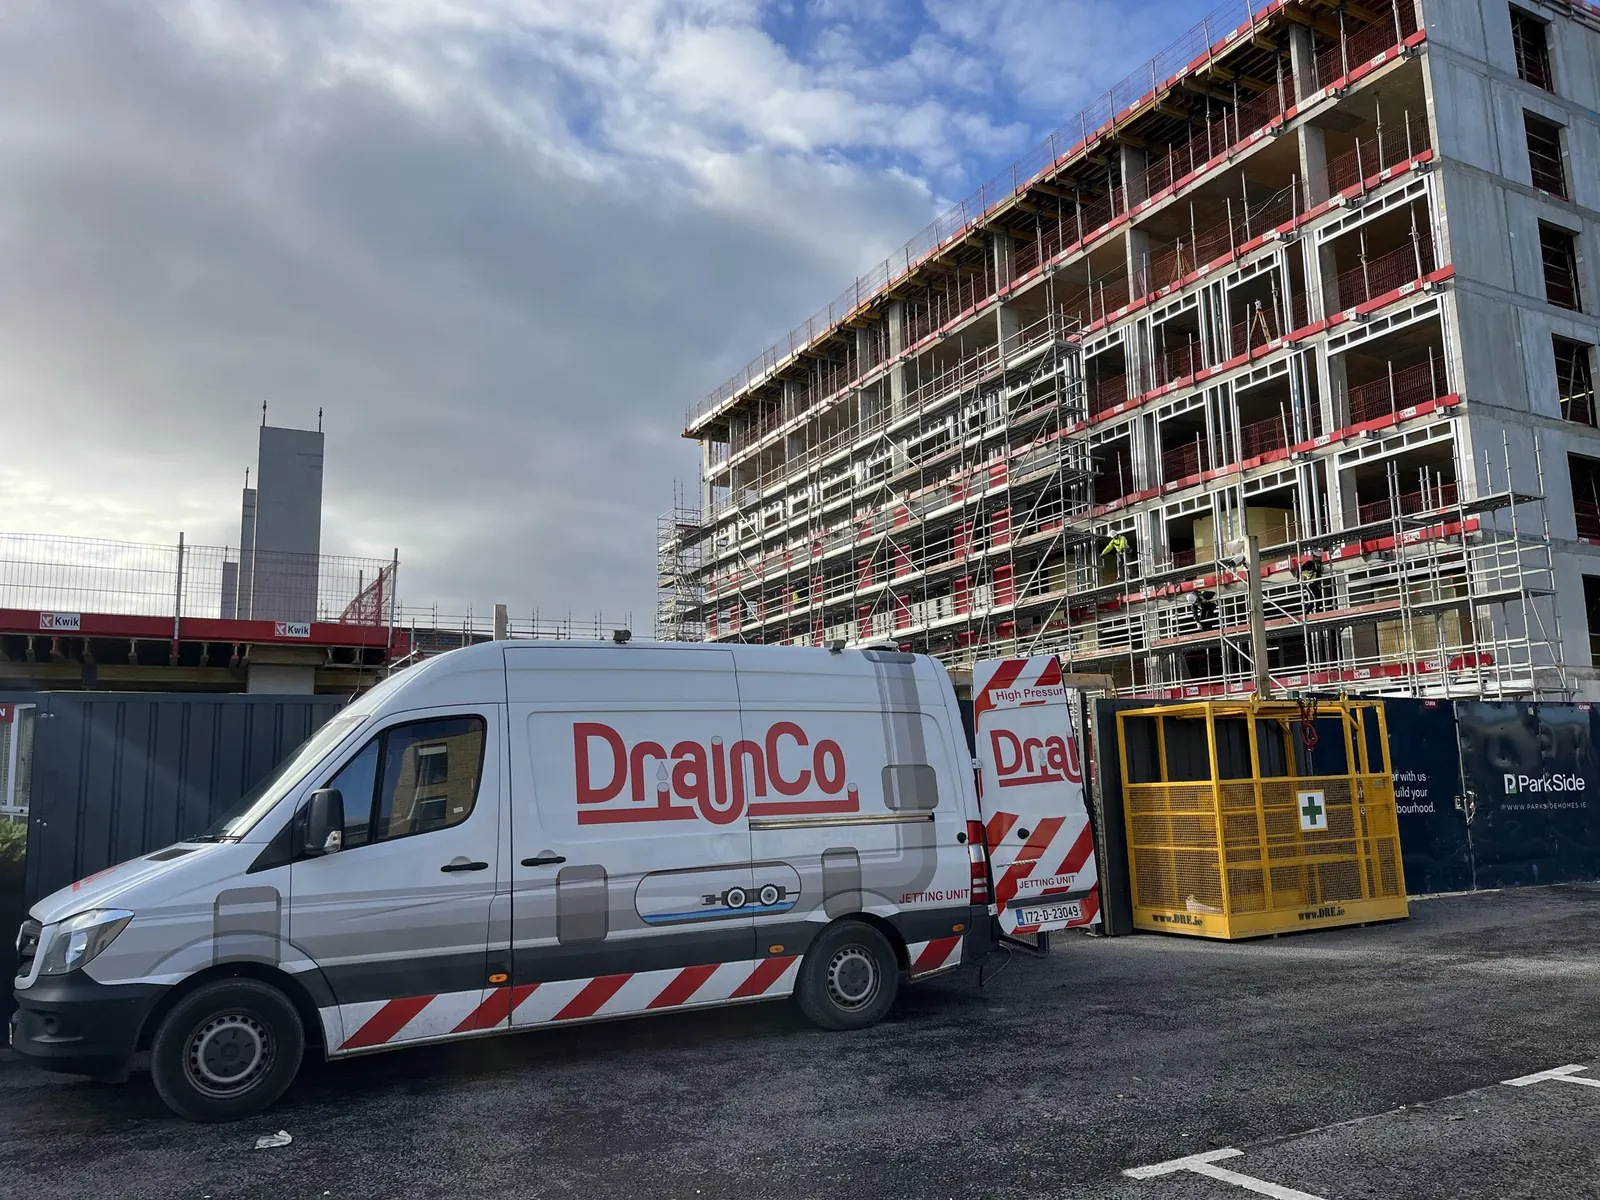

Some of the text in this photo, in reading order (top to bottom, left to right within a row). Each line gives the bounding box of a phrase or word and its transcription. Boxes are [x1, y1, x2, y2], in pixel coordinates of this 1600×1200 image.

[54, 616, 79, 627] Kwik
[287, 625, 309, 635] Kwik
[996, 689, 1022, 702] High
[573, 721, 859, 825] DrainCo
[1400, 770, 1417, 782] with
[1417, 772, 1427, 782] us
[1393, 786, 1428, 801] uild your
[1396, 801, 1436, 814] bourhood.
[1019, 875, 1075, 889] JETTING UNIT
[899, 888, 970, 904] JETTING UNIT
[1025, 905, 1079, 923] 172-D-23049
[1152, 914, 1203, 926] www.DRE.ie
[1298, 906, 1345, 921] www.DRE.ie
